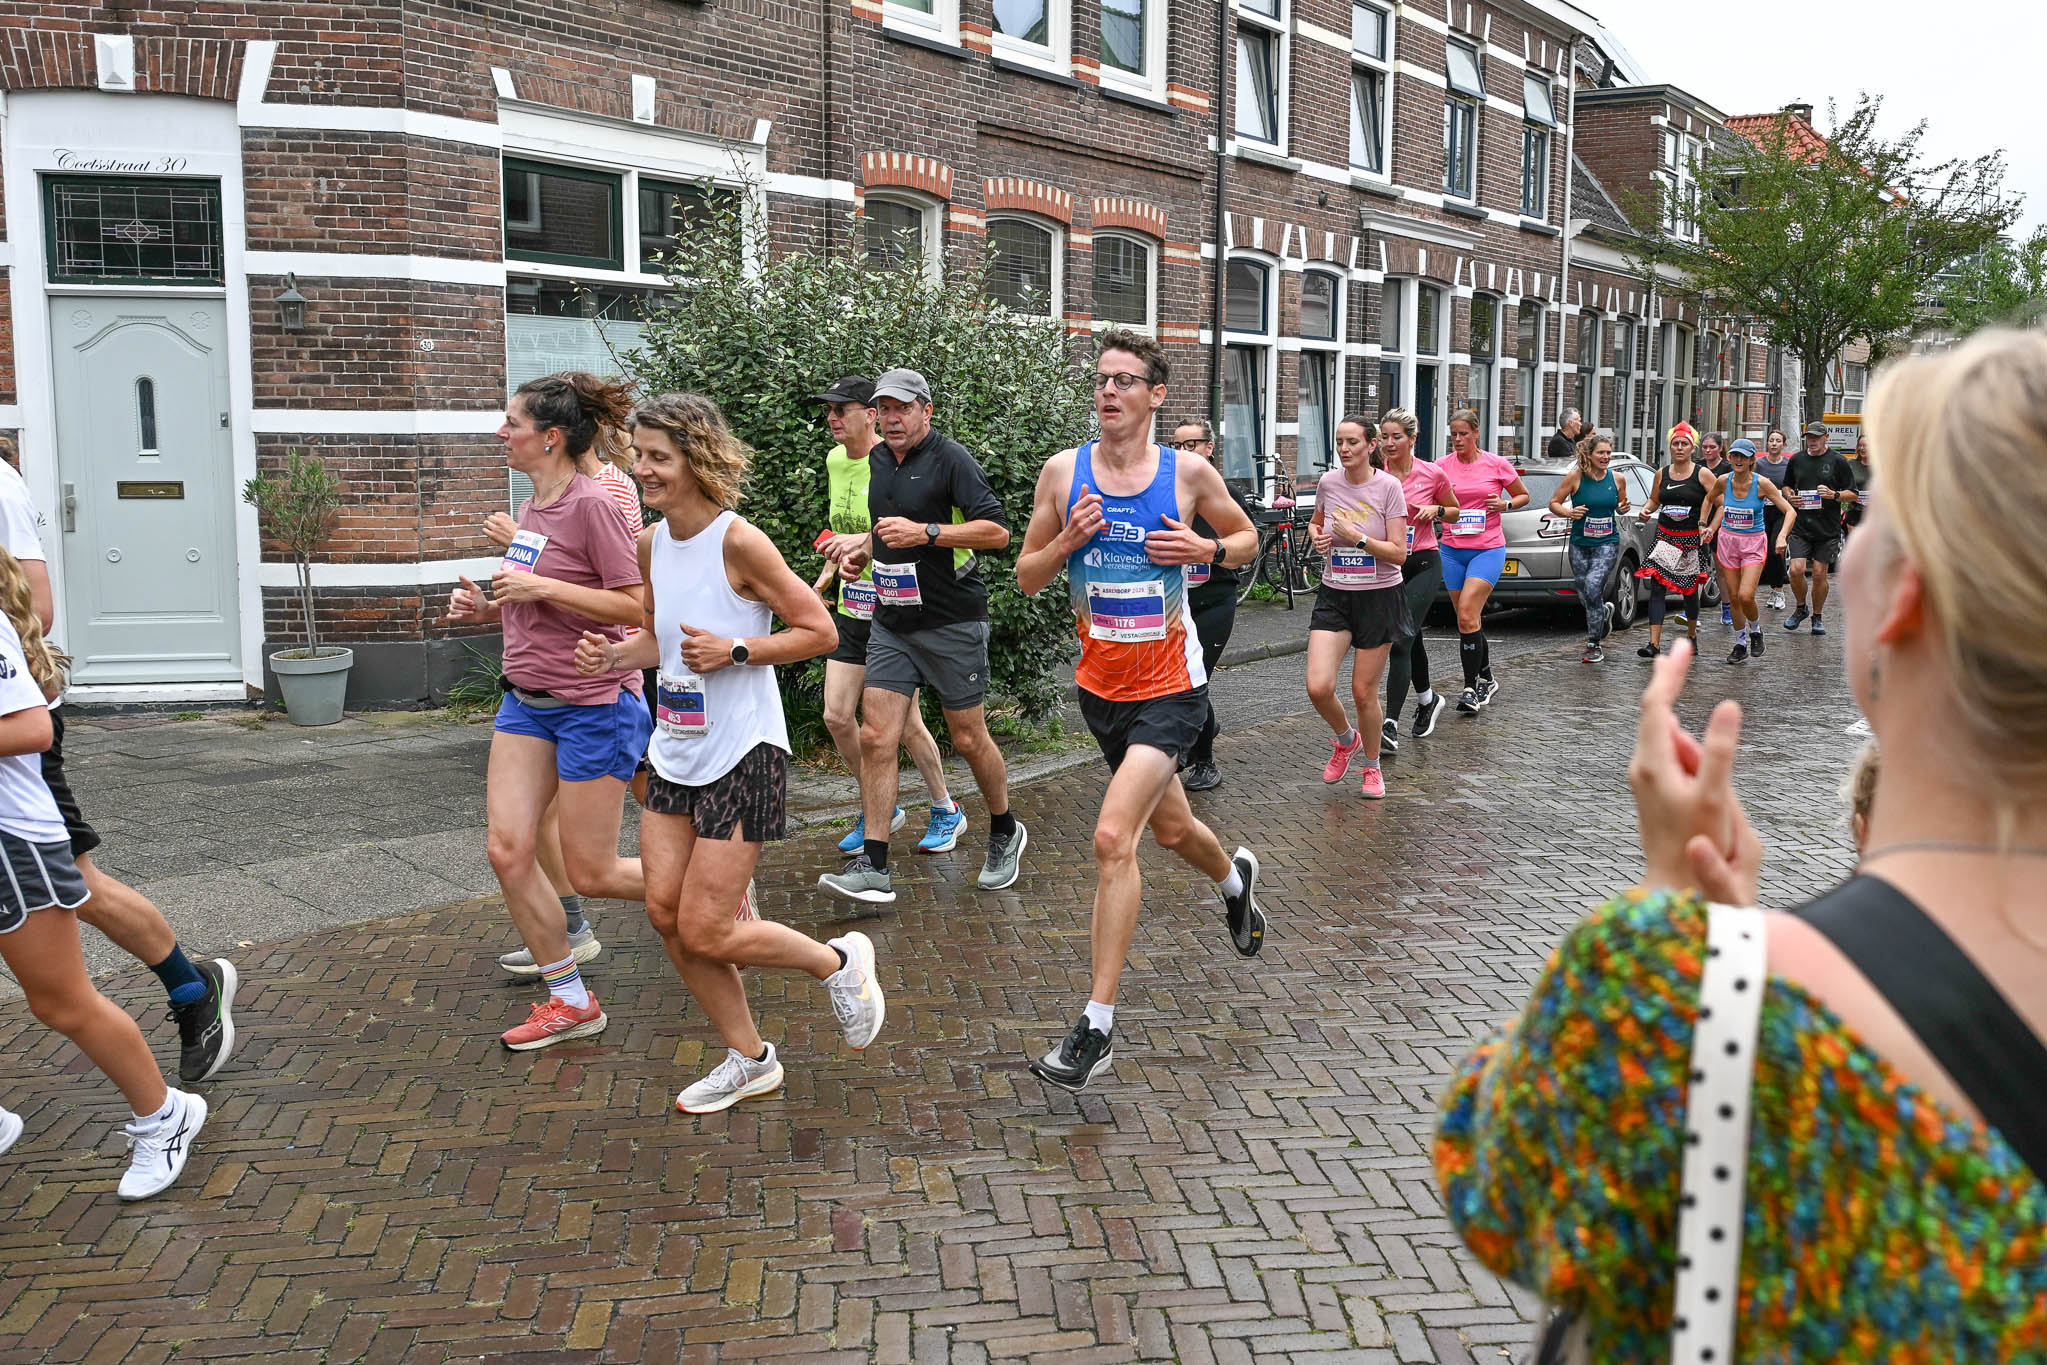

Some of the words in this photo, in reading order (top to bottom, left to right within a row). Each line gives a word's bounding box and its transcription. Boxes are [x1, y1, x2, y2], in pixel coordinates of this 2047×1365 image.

[53, 148, 150, 171] Coetsstraat
[155, 156, 187, 173] 30
[1340, 557, 1364, 566] 1342
[880, 577, 898, 587] ROB
[847, 591, 877, 602] MARCE
[882, 589, 898, 597] 4001
[856, 602, 872, 610] 4007
[1114, 618, 1136, 628] 1176
